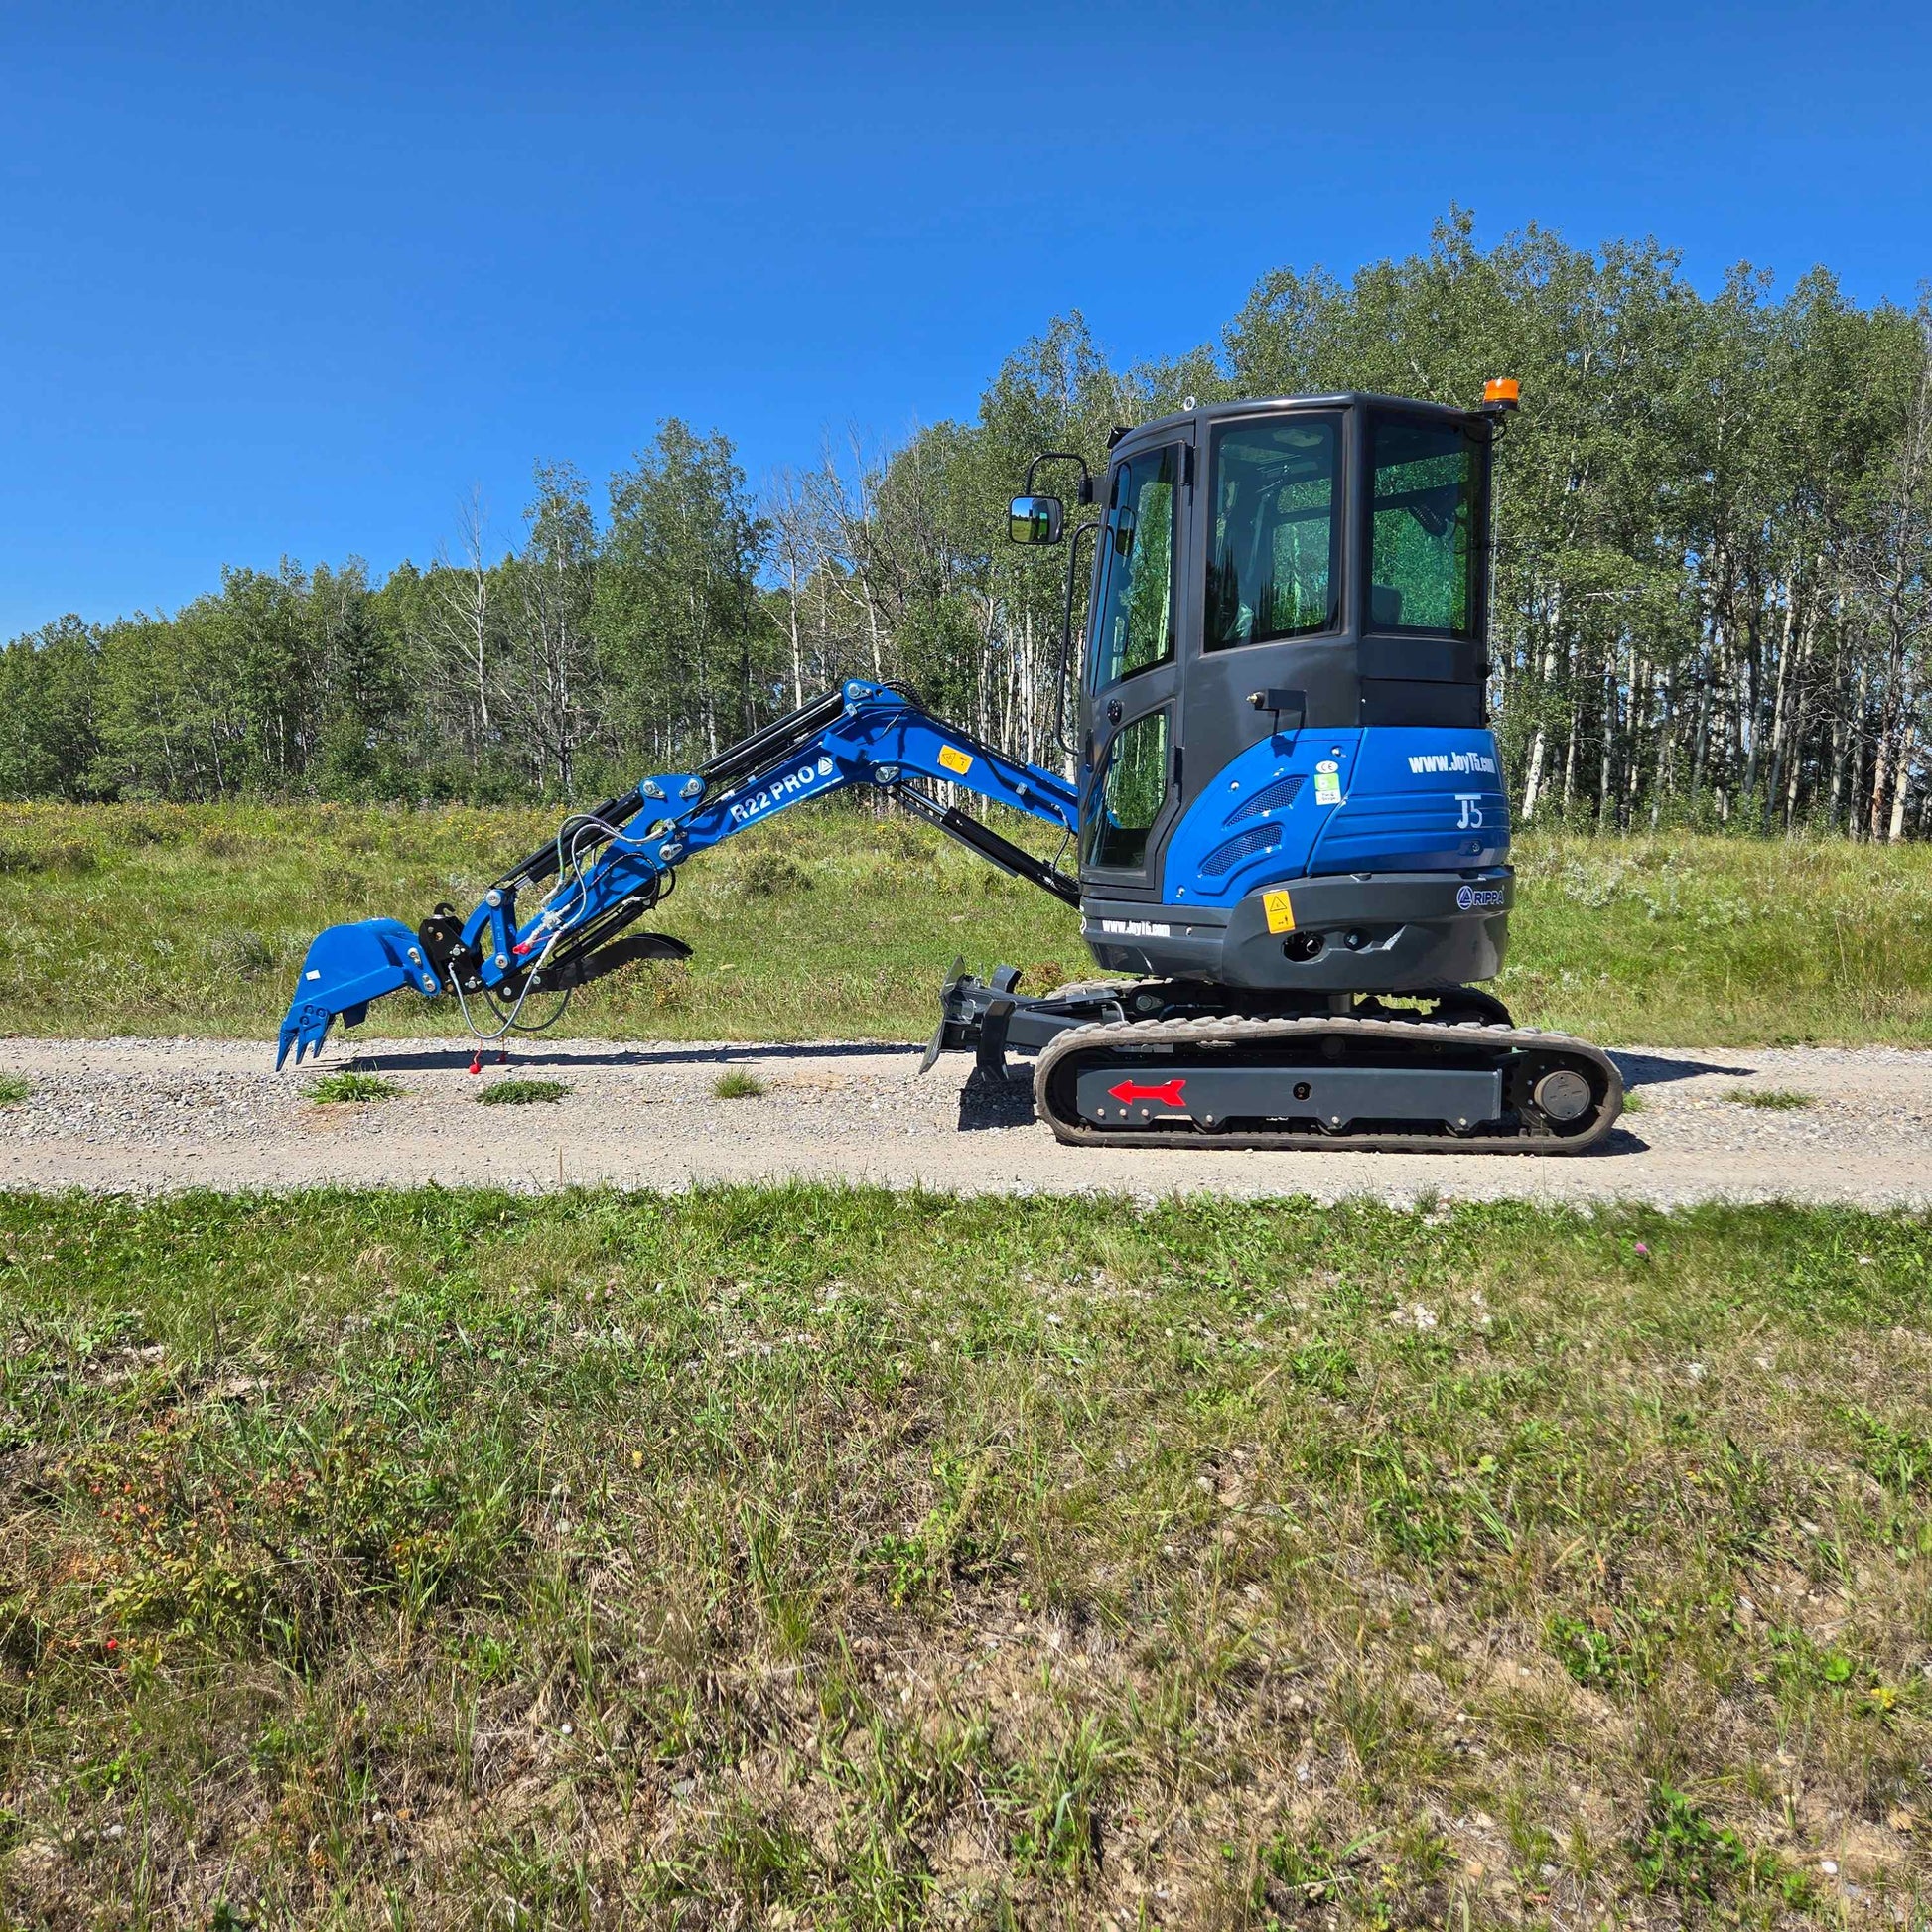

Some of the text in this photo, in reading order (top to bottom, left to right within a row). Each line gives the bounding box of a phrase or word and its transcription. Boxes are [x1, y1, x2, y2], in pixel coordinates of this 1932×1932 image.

[730, 765, 815, 823] R22 PRO
[1472, 890, 1505, 906] RIPPA
